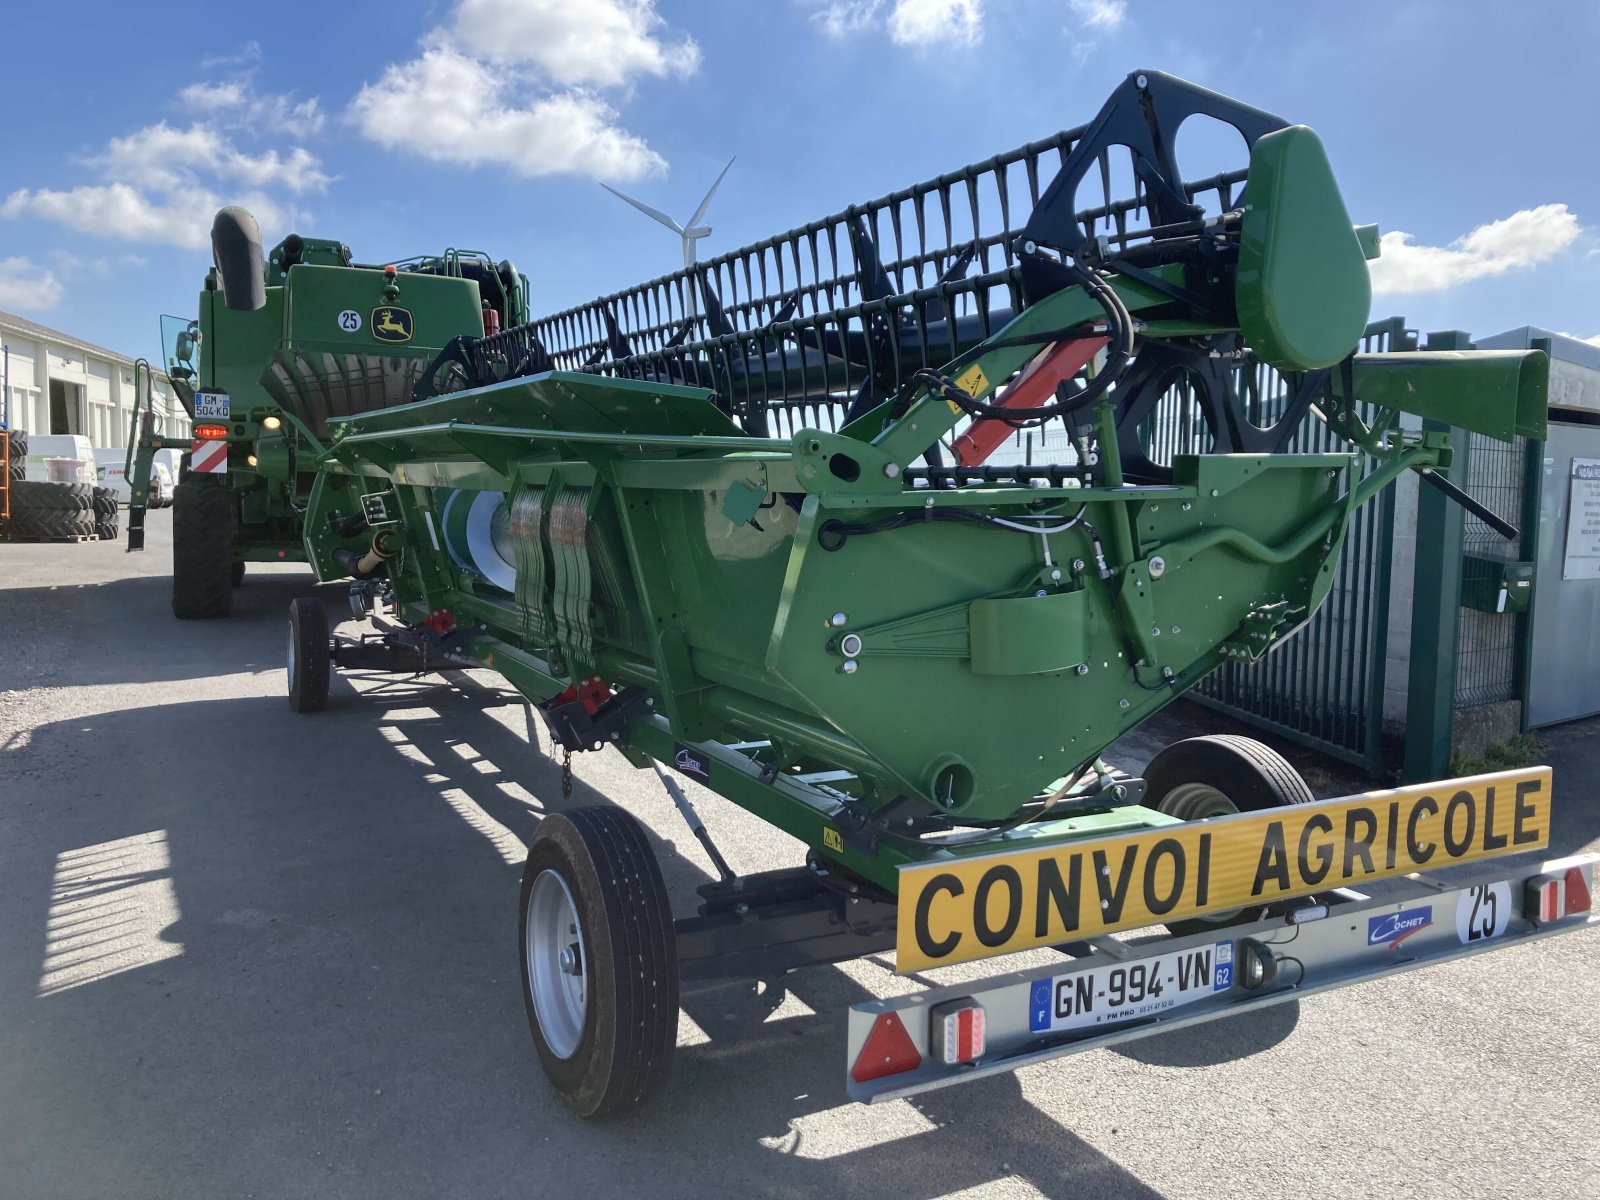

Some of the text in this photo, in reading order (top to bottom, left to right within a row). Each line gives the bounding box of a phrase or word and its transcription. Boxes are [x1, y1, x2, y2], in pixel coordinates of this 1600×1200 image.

[343, 313, 357, 329] 25
[914, 779, 1542, 958] CONVOI AGRICOLE
[1468, 884, 1497, 941] 25
[1370, 914, 1425, 942] COCHET
[1055, 949, 1211, 1018] GN-994-VN
[1216, 968, 1230, 985] 62
[1038, 1010, 1046, 1023] F
[1107, 1012, 1118, 1020] PM
[1119, 1009, 1135, 1018] PRO
